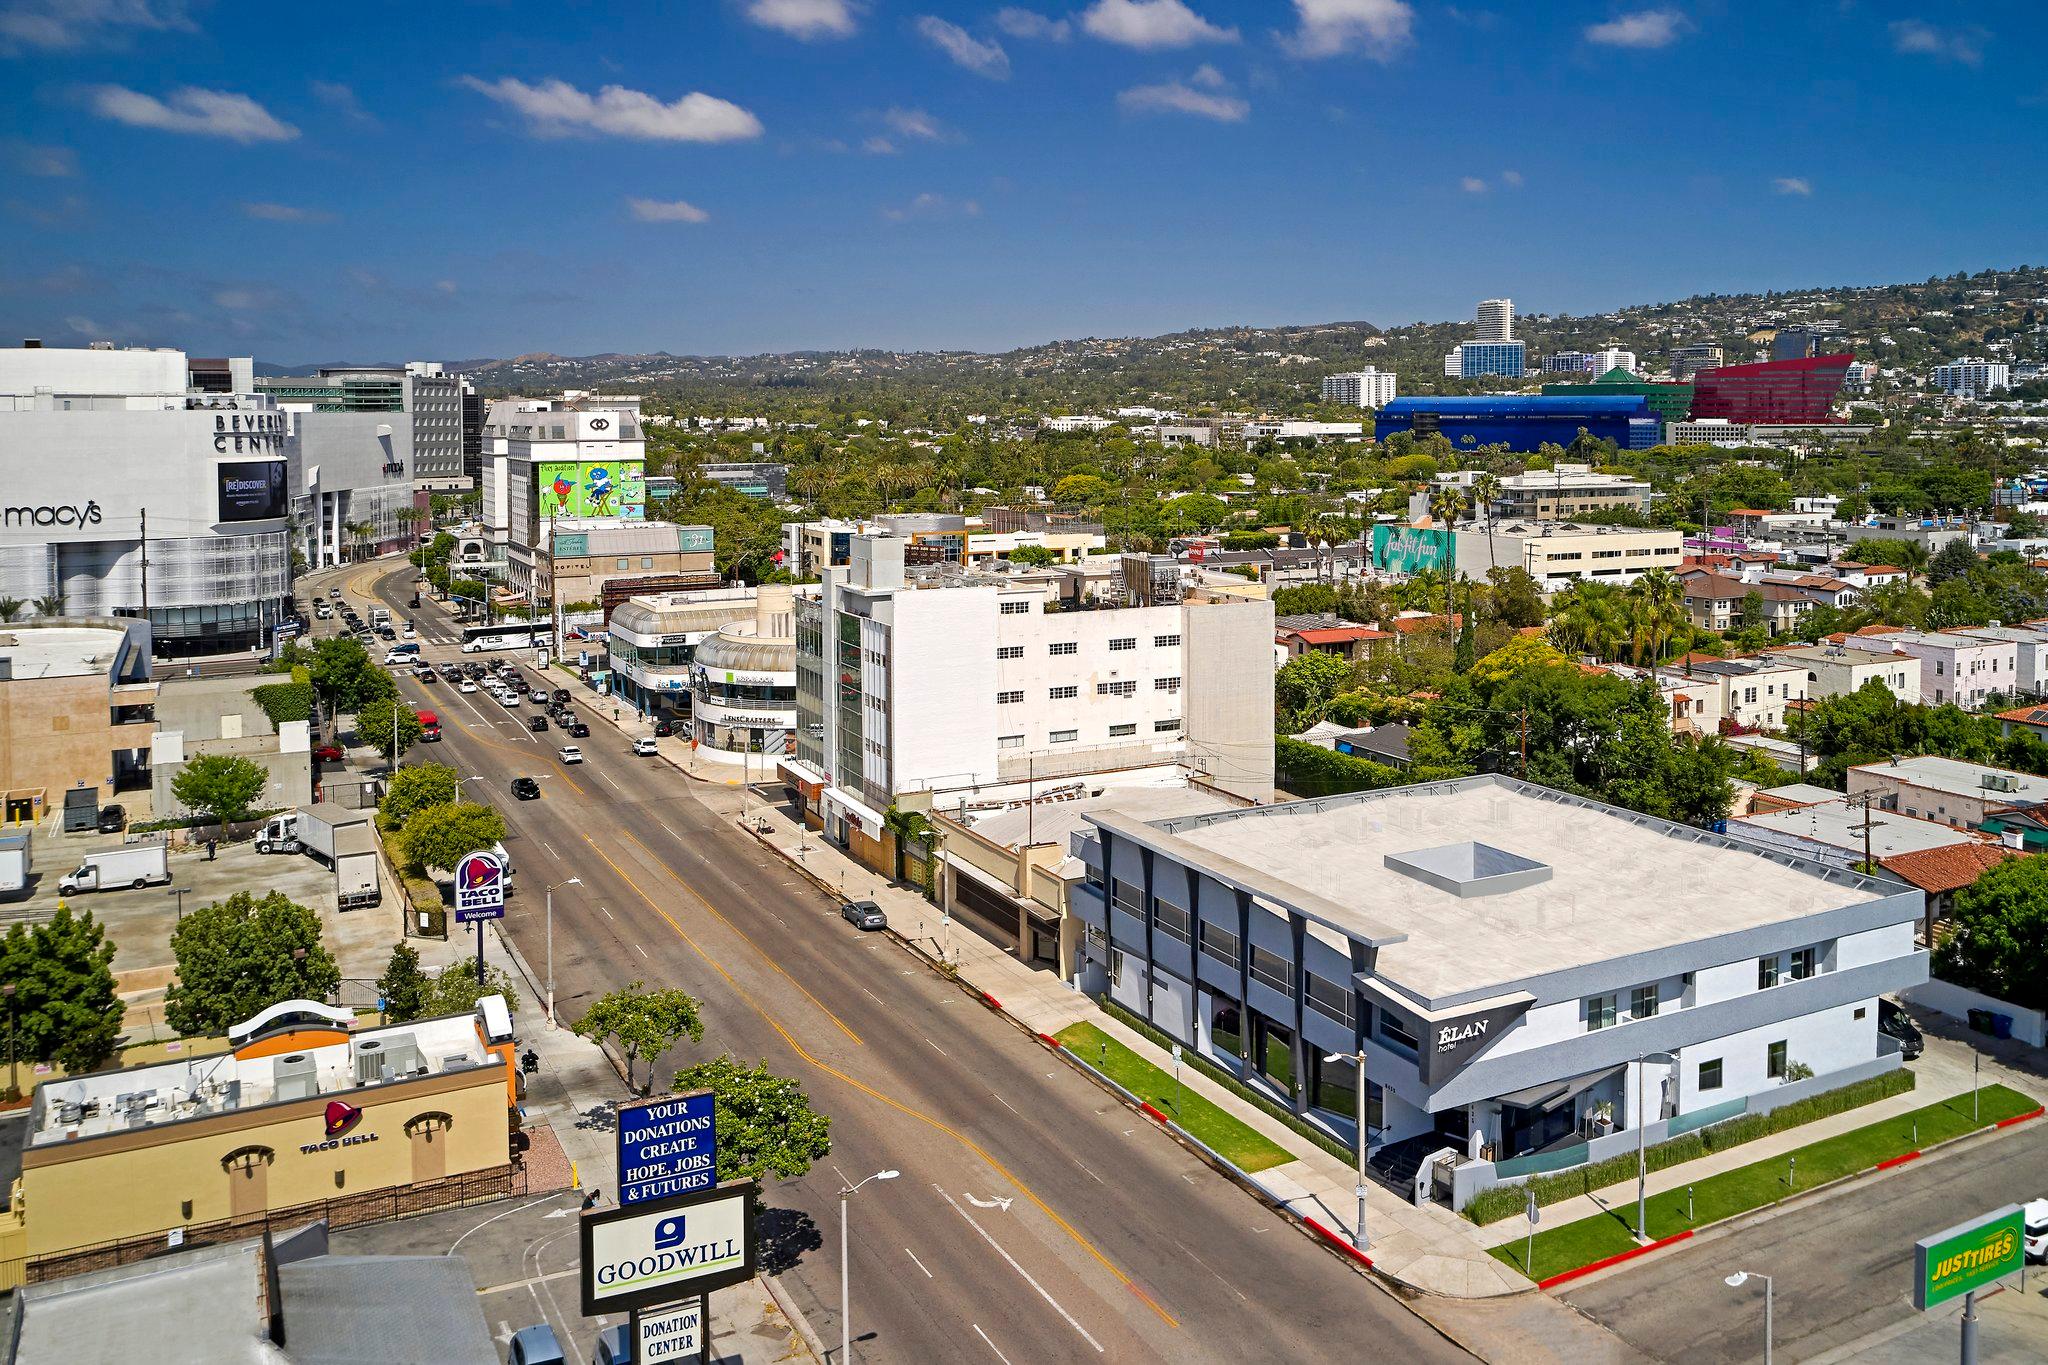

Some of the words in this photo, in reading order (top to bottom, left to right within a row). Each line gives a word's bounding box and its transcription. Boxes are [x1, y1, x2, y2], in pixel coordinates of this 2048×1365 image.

[216, 415, 282, 429] BEVERLY
[214, 436, 284, 450] CENTER
[5, 500, 102, 530] macy's
[480, 635, 503, 644] TCS
[459, 888, 500, 898] TACO
[461, 896, 501, 907] BELL
[464, 911, 497, 920] Welcome
[1438, 1041, 1457, 1053] hotel
[647, 1101, 688, 1121] YOUR
[624, 1116, 711, 1145] DONATIONS
[300, 1138, 339, 1155] TACO
[342, 1132, 379, 1148] BELL
[640, 1137, 698, 1160] CREATE
[626, 1162, 672, 1182] HOPE,
[675, 1153, 711, 1172] JOBS
[628, 1187, 639, 1201] &
[642, 1172, 709, 1198] FUTURES
[597, 1239, 741, 1284] GOODWILL
[643, 1313, 698, 1339] DONATION
[648, 1334, 694, 1358] CENTER
